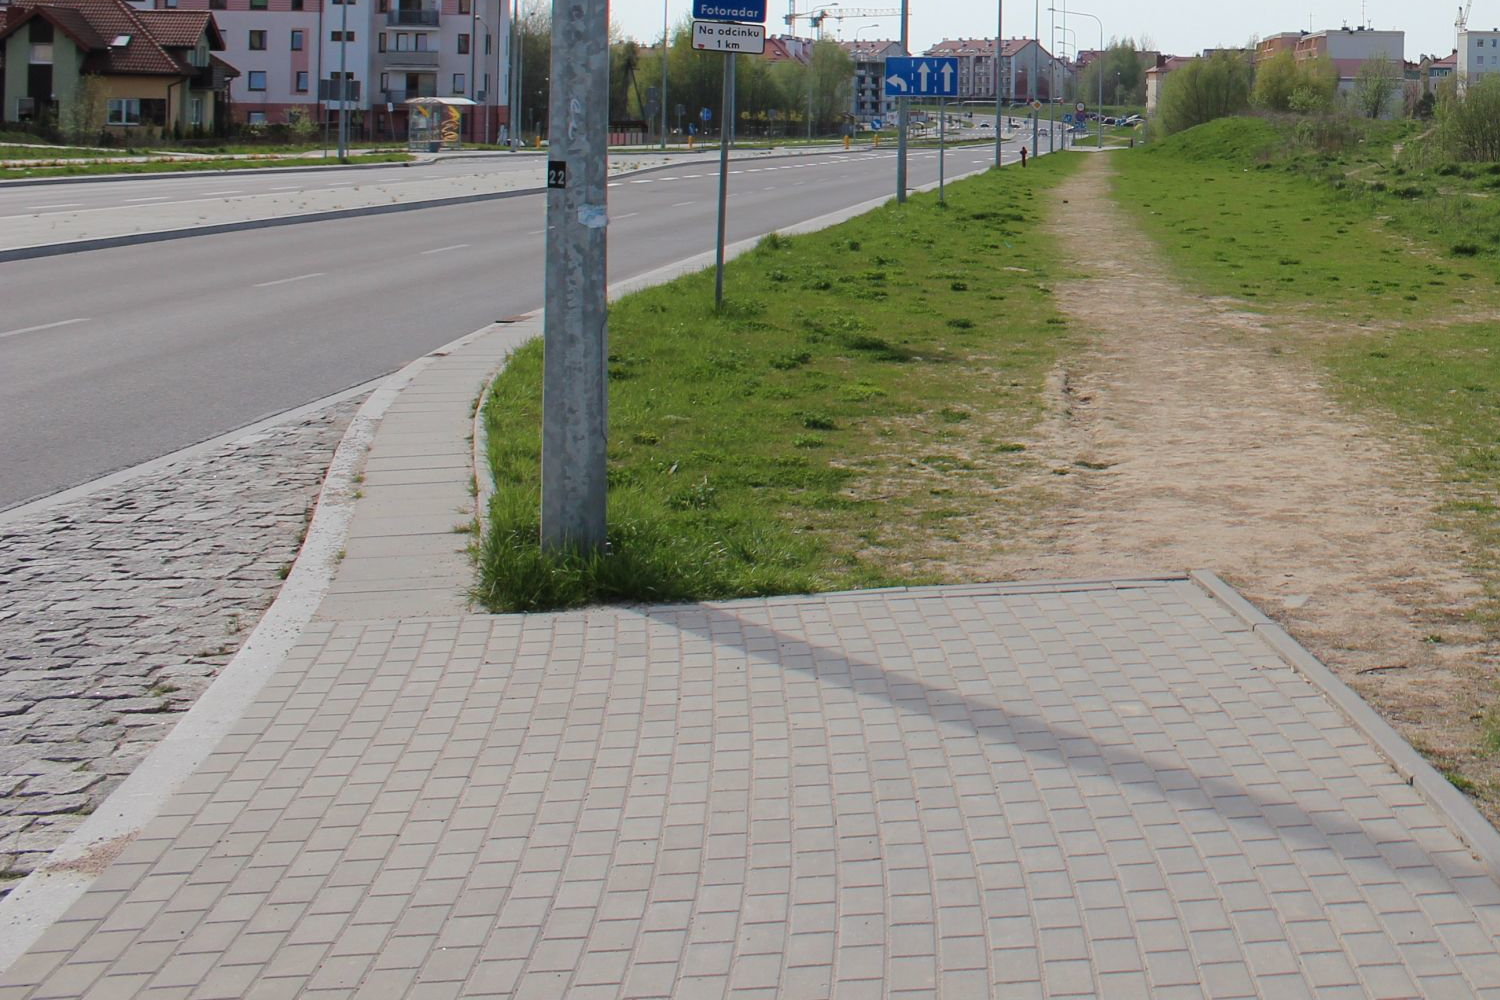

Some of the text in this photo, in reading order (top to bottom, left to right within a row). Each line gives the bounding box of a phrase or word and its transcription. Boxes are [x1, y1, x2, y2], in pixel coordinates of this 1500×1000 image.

[701, 4, 759, 18] Fotoradar
[699, 26, 760, 38] Na odcinku
[717, 40, 740, 49] 1 km
[549, 170, 565, 185] 22
